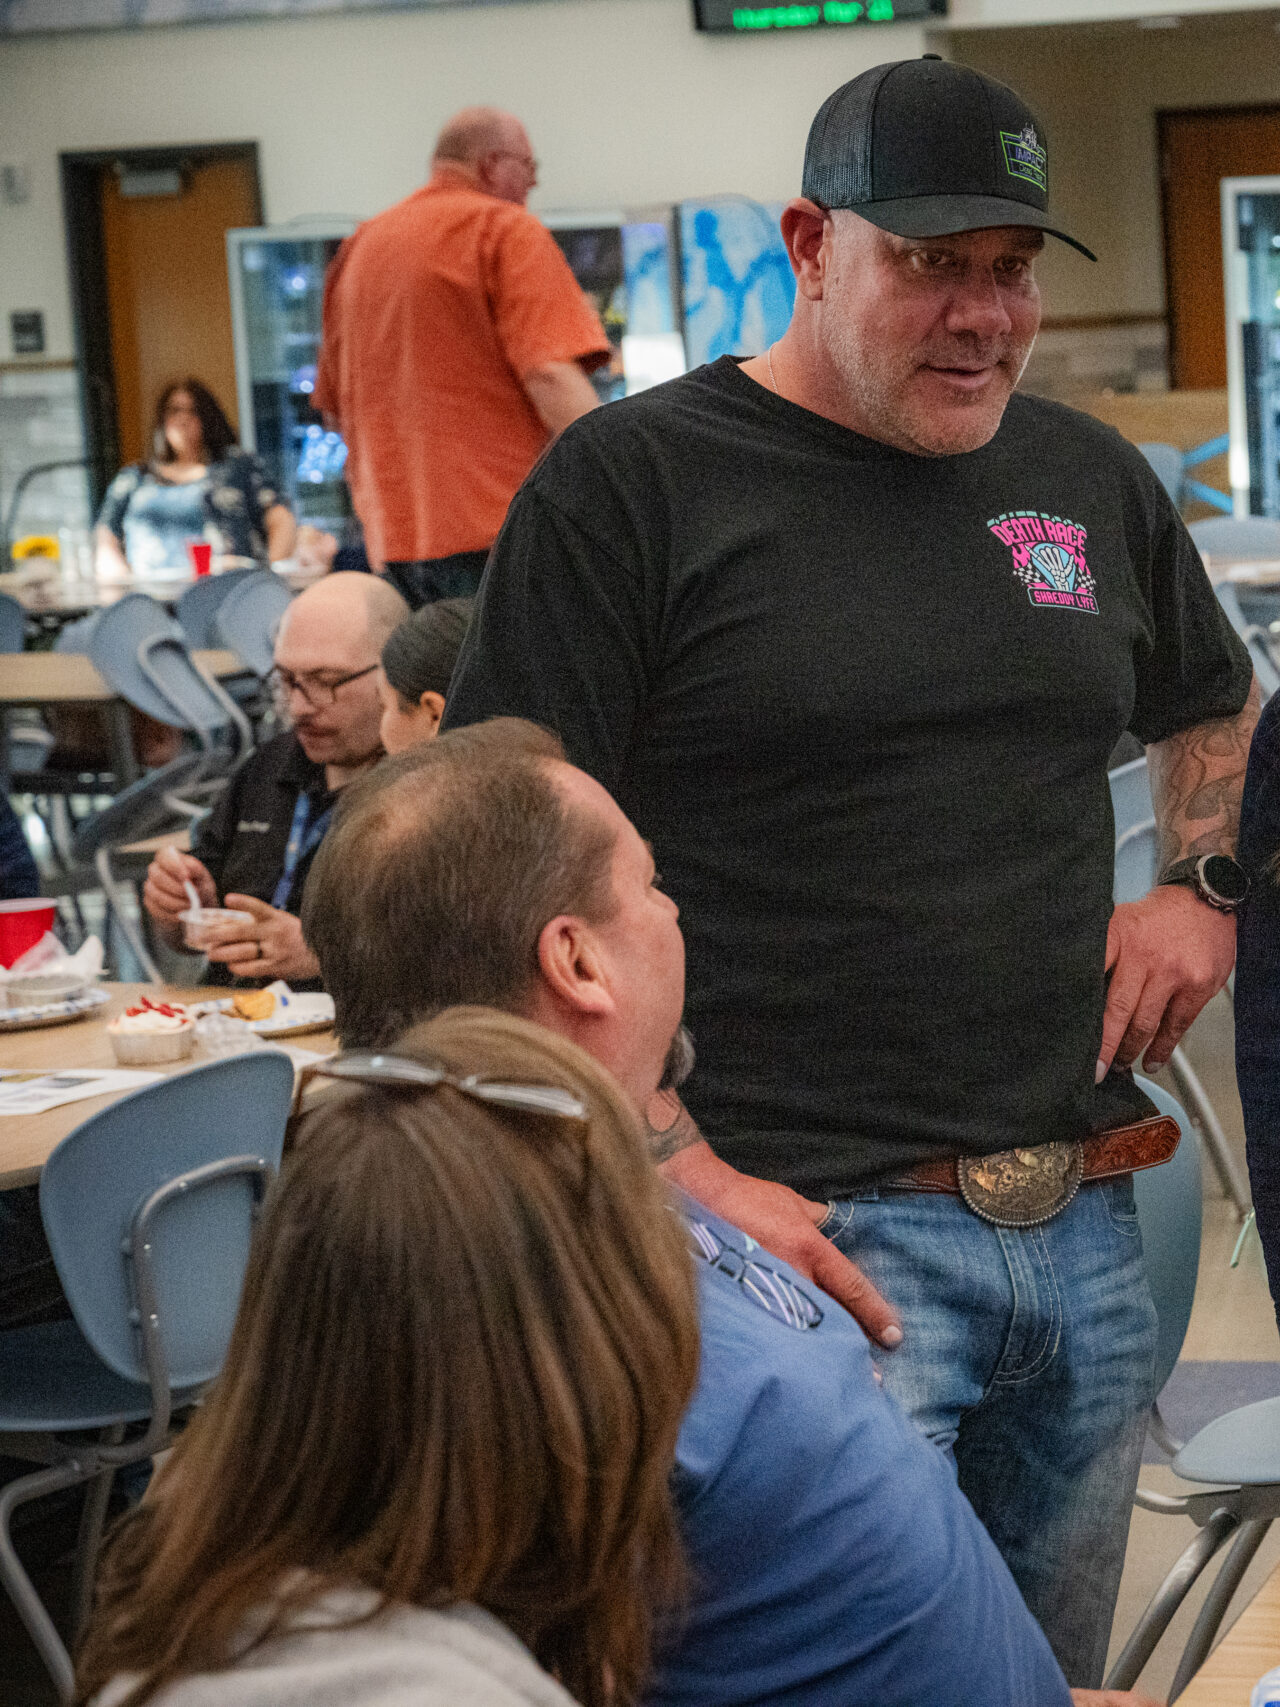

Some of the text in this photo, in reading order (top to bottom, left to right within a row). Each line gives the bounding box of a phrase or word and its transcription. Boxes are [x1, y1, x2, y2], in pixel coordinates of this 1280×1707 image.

[990, 518, 1087, 552] DEATH RACE
[1034, 590, 1095, 610] SHREDDY LYFE
